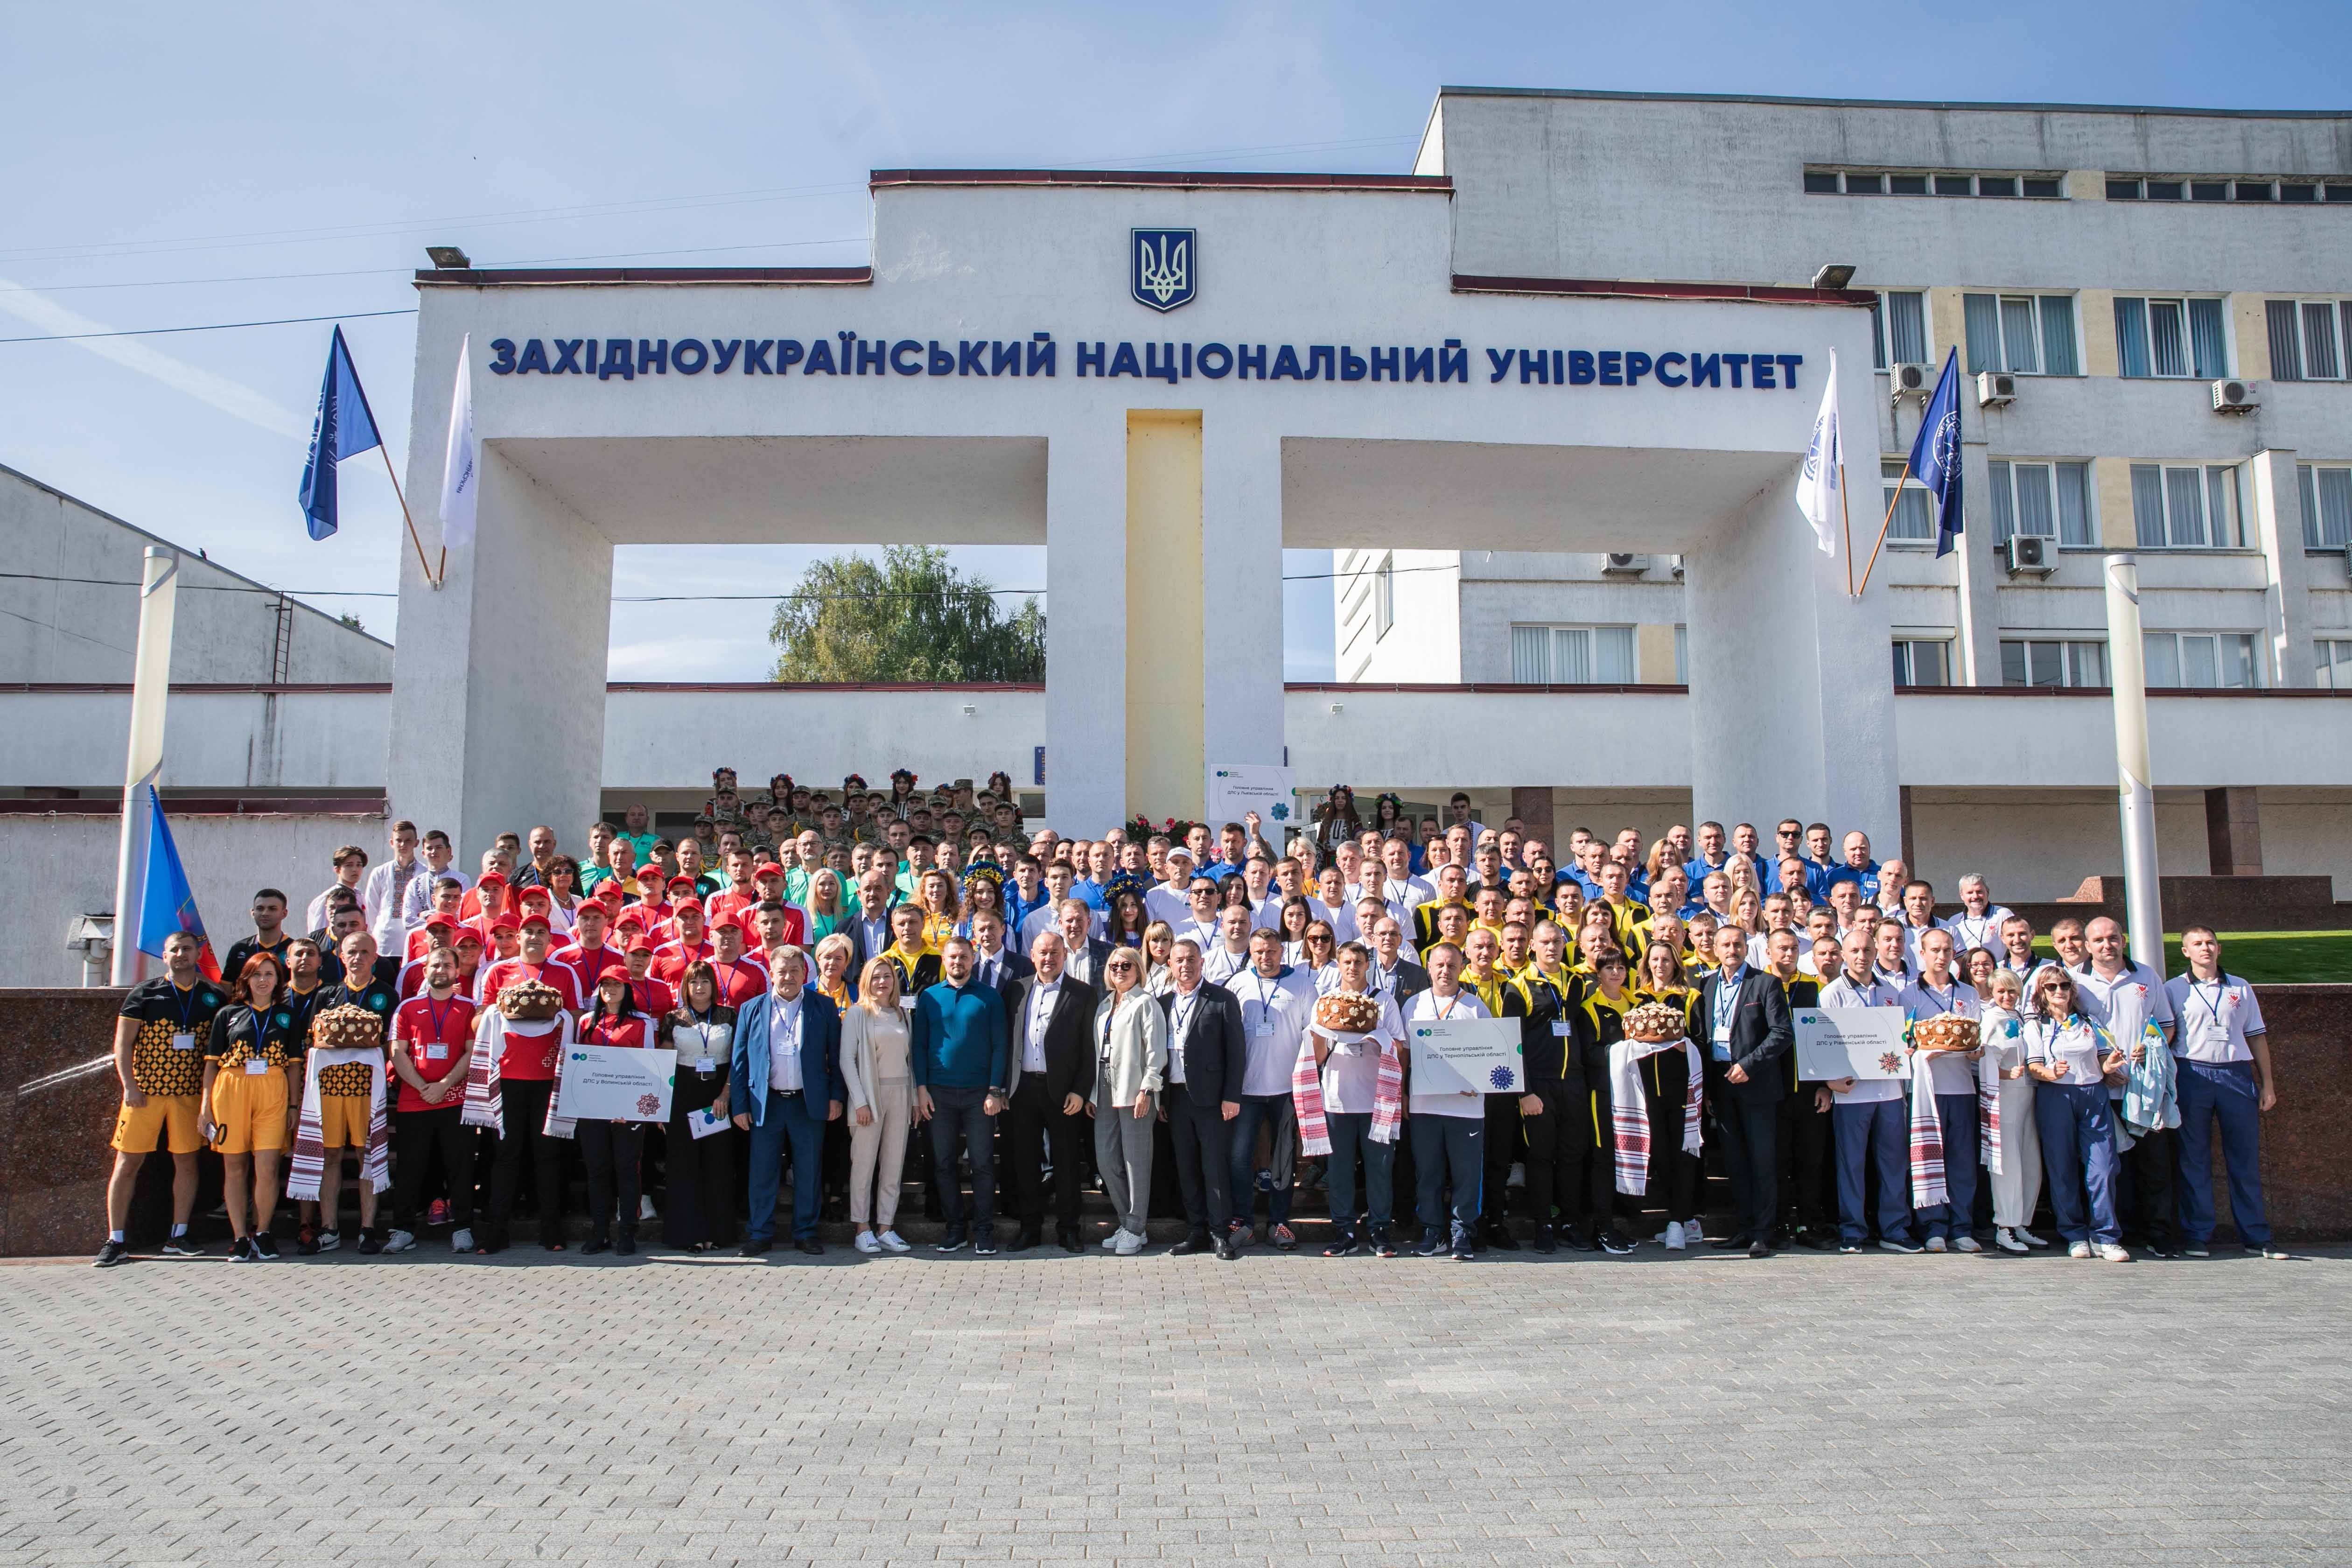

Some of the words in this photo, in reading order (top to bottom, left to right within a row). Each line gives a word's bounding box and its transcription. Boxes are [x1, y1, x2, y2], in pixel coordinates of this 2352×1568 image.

[489, 331, 1056, 380] ЗАХІДНОУКРАЇНСЬКИЙ
[1077, 339, 1468, 384] НАЦІОНАЛЬНИЙ
[1485, 348, 1803, 389] УНІВЕРСИТЕТ
